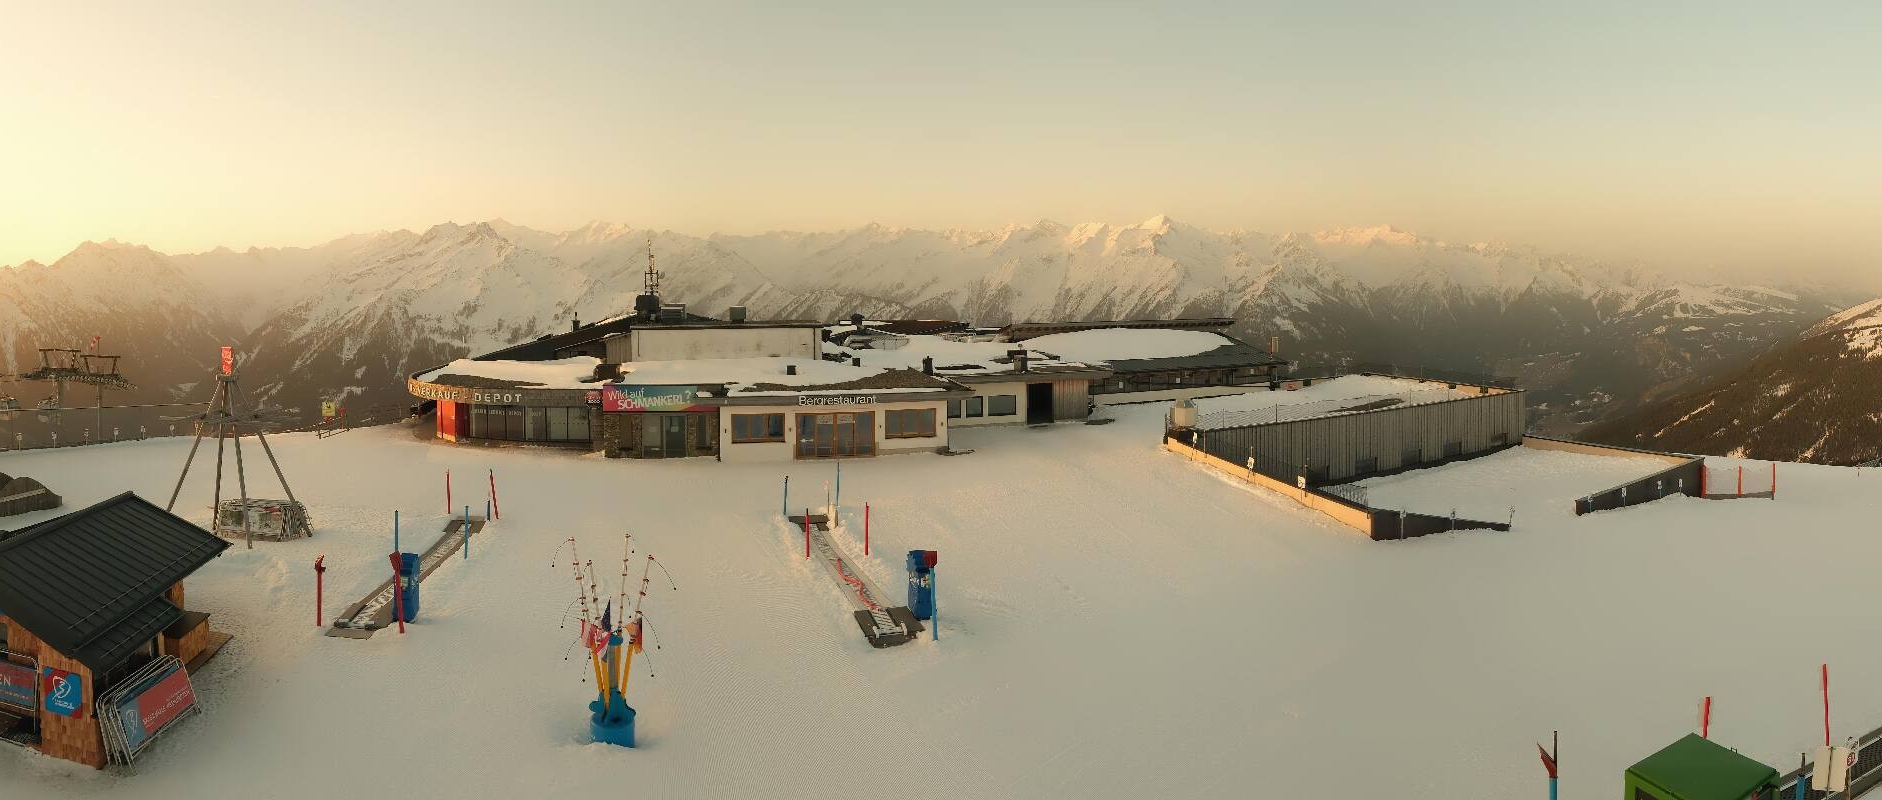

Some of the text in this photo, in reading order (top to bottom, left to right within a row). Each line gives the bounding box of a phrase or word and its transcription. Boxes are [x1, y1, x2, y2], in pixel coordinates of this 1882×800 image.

[474, 392, 522, 403] DEPOT
[629, 387, 645, 399] auf
[798, 394, 877, 406] Bergrestaurant
